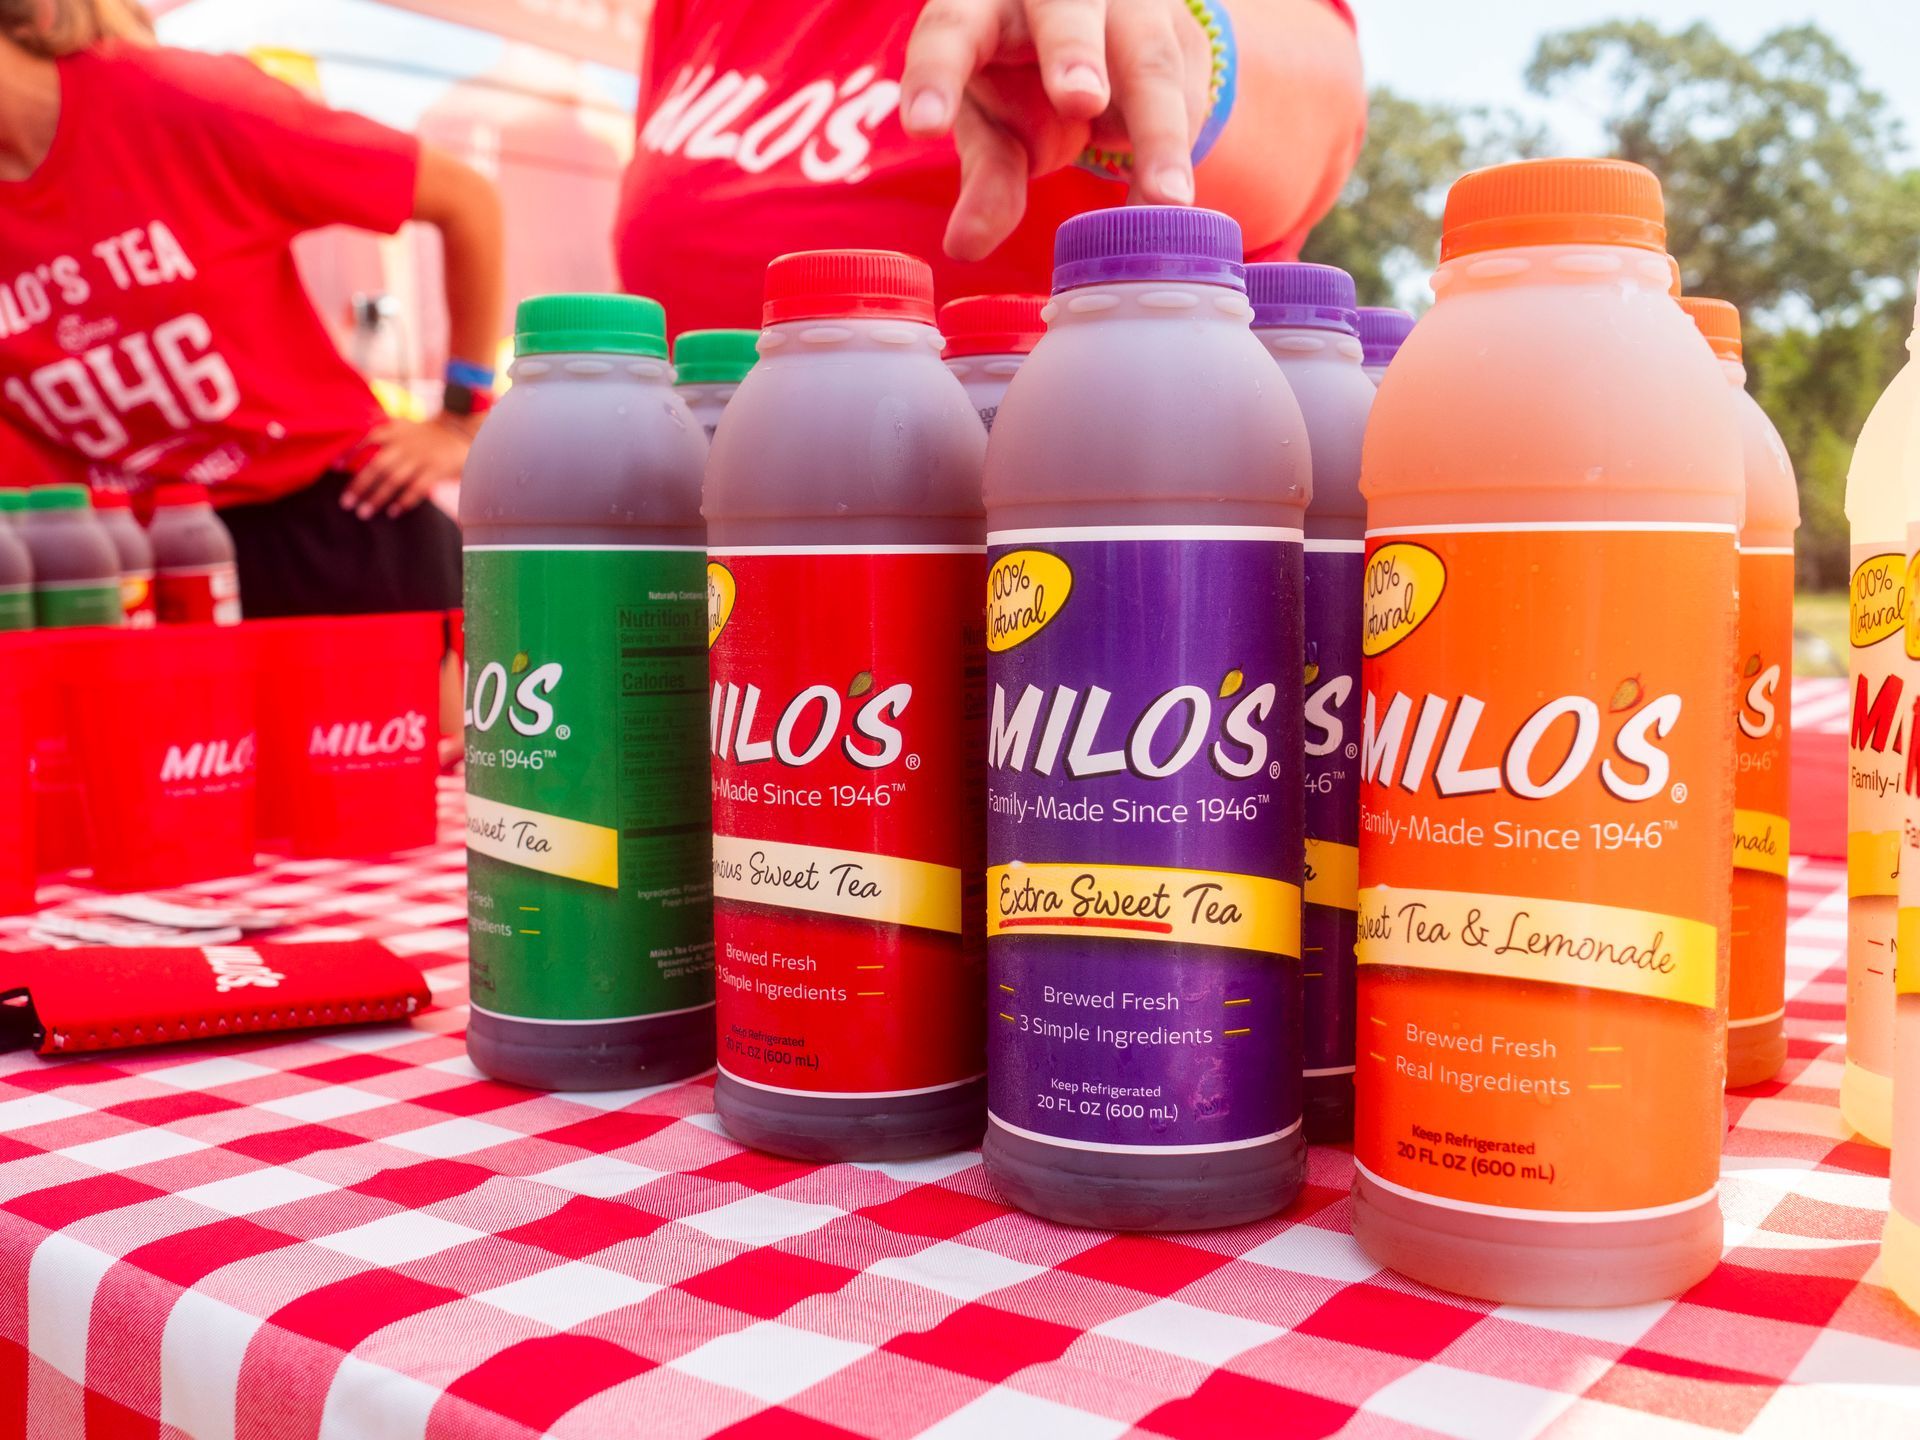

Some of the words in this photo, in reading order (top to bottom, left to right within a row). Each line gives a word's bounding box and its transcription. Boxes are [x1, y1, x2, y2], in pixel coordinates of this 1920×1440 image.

[92, 219, 197, 291] TEA
[5, 313, 240, 459] 1946
[992, 559, 1030, 602] 100%
[1856, 565, 1893, 600] 100%
[620, 608, 690, 628] Nutrition
[622, 672, 686, 690] Calories
[309, 710, 427, 757] MILO'S
[763, 783, 822, 807] Since
[988, 788, 1104, 824] Family-Made
[1112, 798, 1188, 824] Since
[512, 821, 552, 853] Tea
[1361, 804, 1484, 847] Family-Made
[1494, 821, 1581, 850] Since
[750, 851, 819, 891] Sweet
[830, 863, 882, 898] Tea
[999, 873, 1063, 916] Extra
[1070, 873, 1170, 919] Sweet
[1183, 882, 1242, 925] Tea
[726, 942, 768, 967] Brewed
[772, 953, 817, 972] Fresh
[1398, 903, 1451, 943] Tea
[1461, 908, 1490, 947] &
[1494, 911, 1677, 976] Lemonade
[722, 967, 752, 992] Simple
[756, 979, 847, 1001] Ingredients
[1043, 985, 1115, 1010] Brewed
[1122, 992, 1179, 1011] Fresh
[749, 1029, 805, 1047] Refrigerated
[1020, 1014, 1029, 1032] 3
[1033, 1018, 1090, 1042] Simple
[1097, 1025, 1213, 1049] Ingredients
[1406, 1023, 1483, 1054] Brewed
[1491, 1036, 1557, 1059] Fresh
[735, 1041, 746, 1056] FL
[763, 1049, 792, 1065] (600
[795, 1054, 819, 1070] mL)
[1050, 1078, 1079, 1096] Keep
[1081, 1081, 1161, 1099] Refrigerated
[1395, 1055, 1433, 1082] Real
[1440, 1066, 1571, 1096] Ingredients
[1037, 1094, 1055, 1110] 20
[1058, 1098, 1076, 1114] FL
[1080, 1101, 1101, 1116] OZ
[1105, 1102, 1144, 1121] (600
[1149, 1104, 1179, 1123] mL)
[1411, 1124, 1442, 1146] Keep
[1445, 1132, 1536, 1156] Refrigerated
[1397, 1140, 1417, 1161] 20
[1419, 1147, 1439, 1168] FL
[1442, 1152, 1466, 1172] OZ
[1471, 1155, 1516, 1179] (600
[1521, 1163, 1556, 1184] mL)
